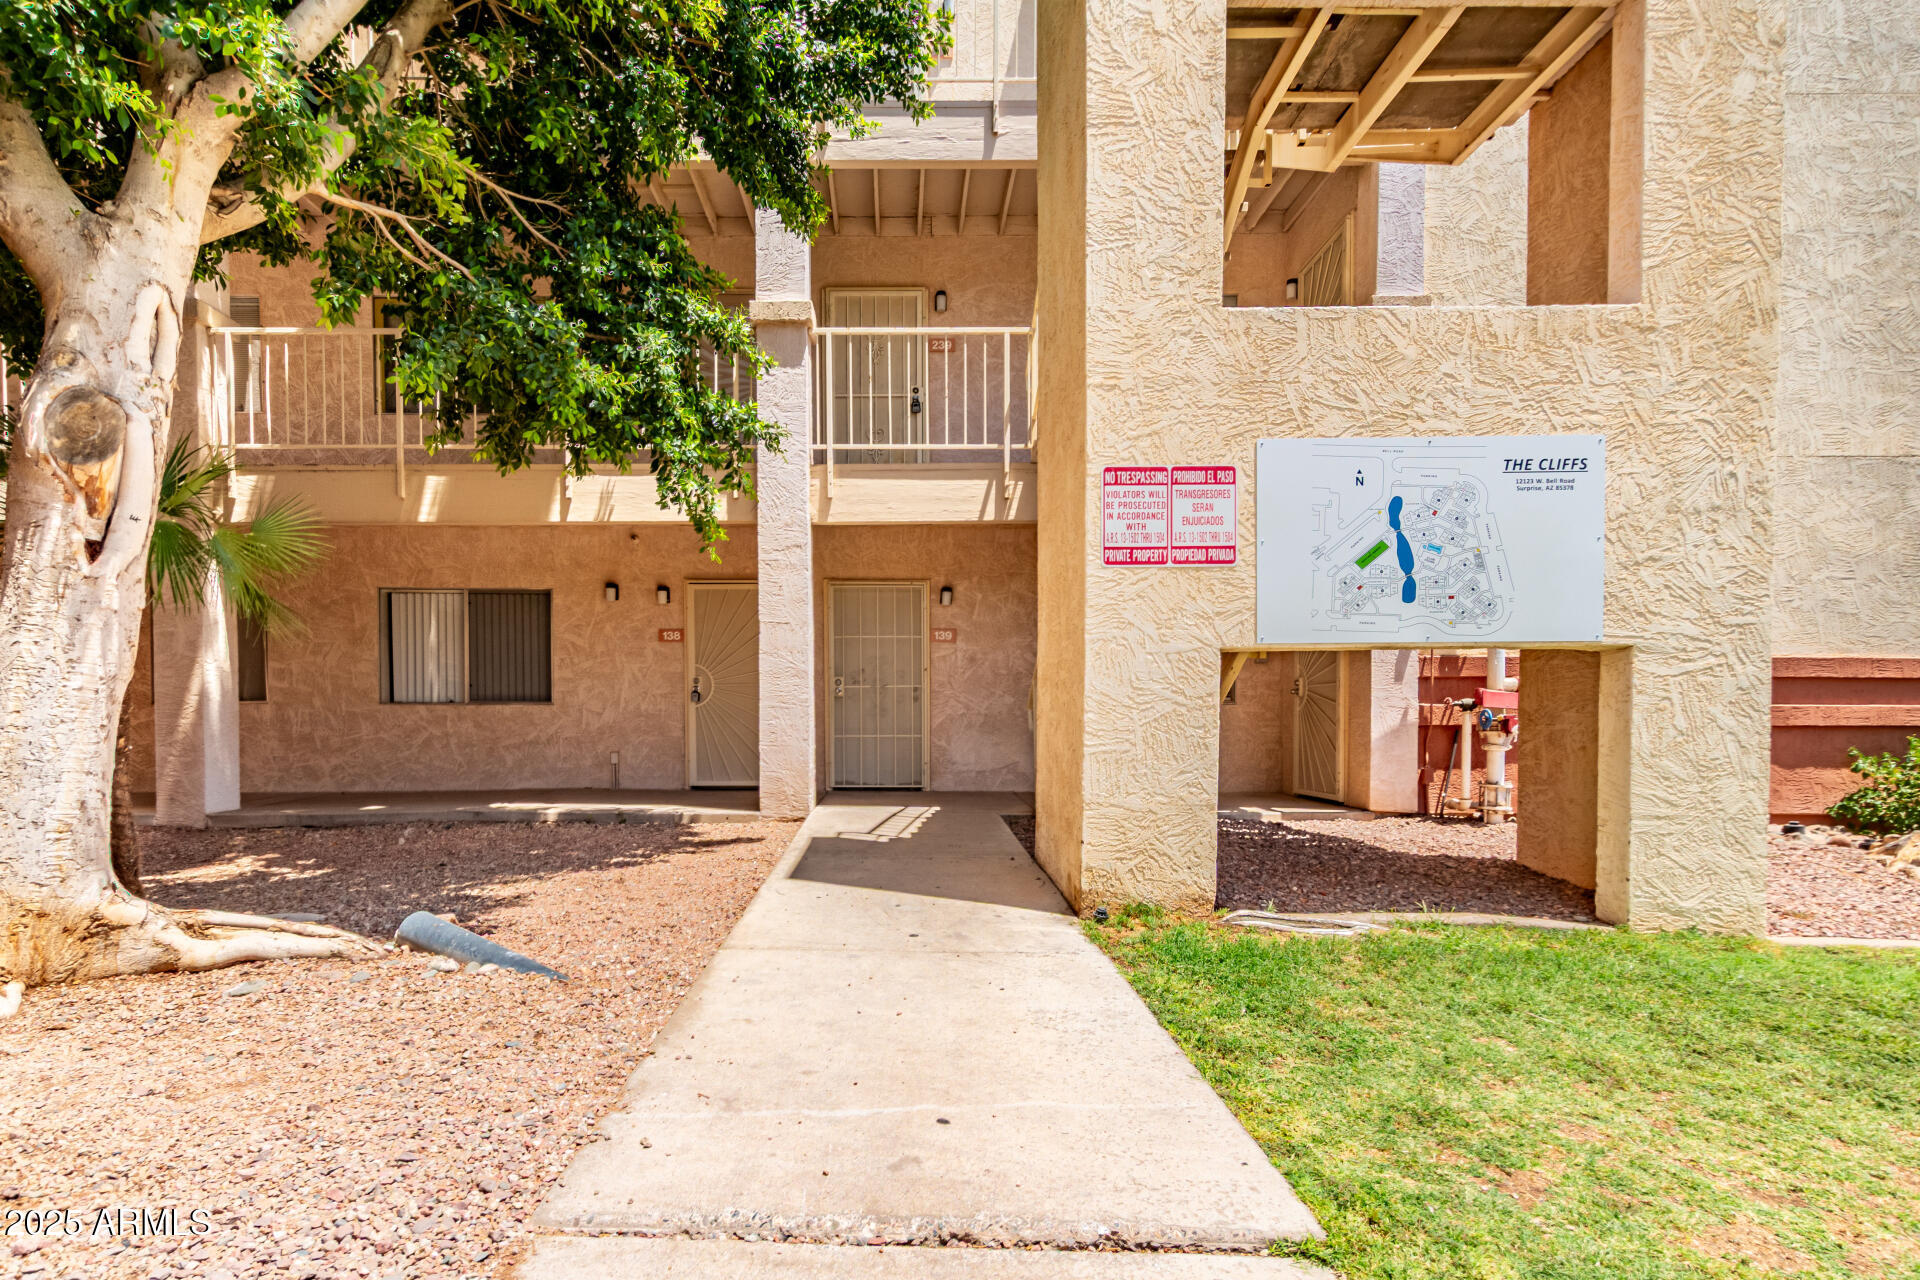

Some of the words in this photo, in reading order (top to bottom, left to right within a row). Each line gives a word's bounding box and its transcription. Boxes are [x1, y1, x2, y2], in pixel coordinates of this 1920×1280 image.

[1503, 459, 1533, 471] THE
[1538, 458, 1588, 470] CLIFFS
[1105, 471, 1115, 484] NO
[1117, 471, 1168, 484] TRESPASSING
[1173, 470, 1205, 483] PROHIBIDO
[1207, 470, 1215, 483] EL
[1217, 470, 1234, 483] PASO
[1355, 476, 1364, 486] N
[1106, 490, 1146, 499] VIOLATORS
[1148, 490, 1167, 499] WILL
[1175, 489, 1231, 499] TRANSGRESORES
[1106, 501, 1115, 510] BE
[1118, 501, 1166, 510] PROSECUTED
[1192, 503, 1214, 512] SERAN
[1106, 512, 1114, 520] IN
[1117, 511, 1165, 520] ACCORDANCE
[1182, 516, 1224, 526] ENJUICIADOS
[1126, 522, 1147, 531] WITH
[1105, 549, 1131, 562] PRIVATE
[1133, 549, 1167, 562] PROPERTY
[1172, 548, 1207, 561] PROPIEDAD
[1208, 548, 1234, 561] PRIVADA
[663, 631, 681, 641] 138
[935, 631, 953, 641] 139
